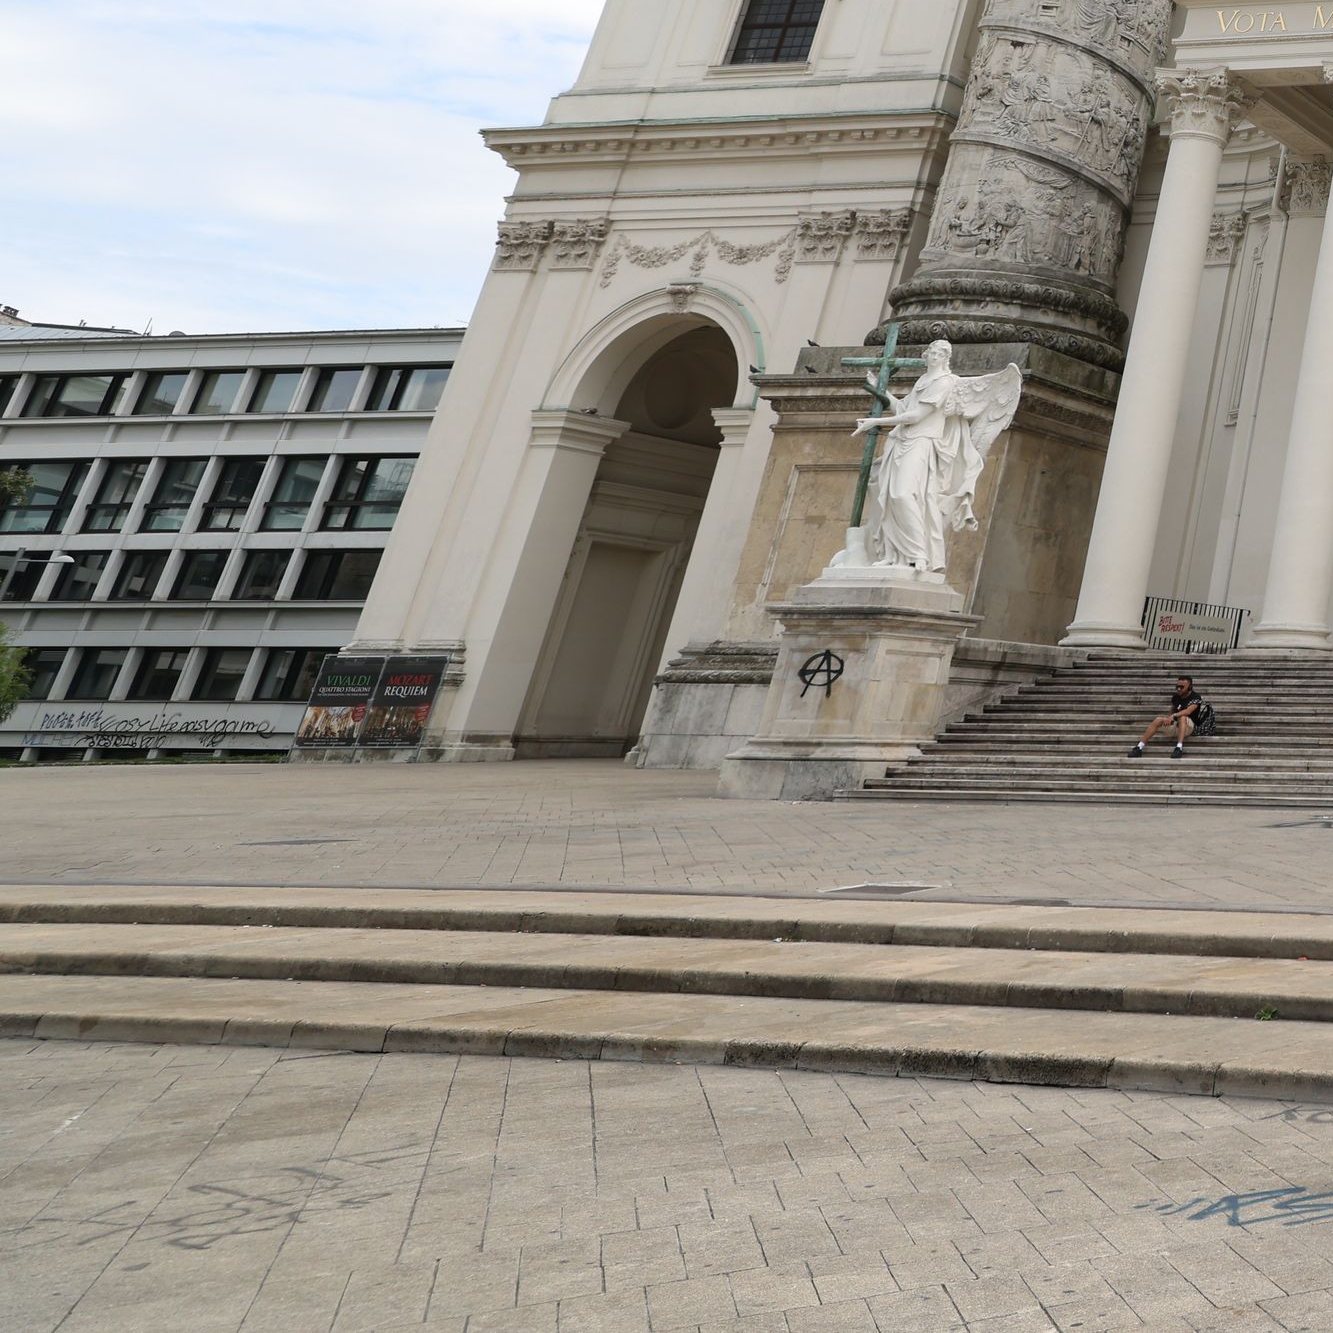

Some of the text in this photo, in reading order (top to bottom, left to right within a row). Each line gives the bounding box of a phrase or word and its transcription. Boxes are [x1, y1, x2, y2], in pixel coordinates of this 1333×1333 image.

[1216, 10, 1287, 33] VOTA
[327, 675, 371, 685] VIVALDI
[387, 674, 433, 685] MOZART
[384, 686, 428, 698] REQUIEM
